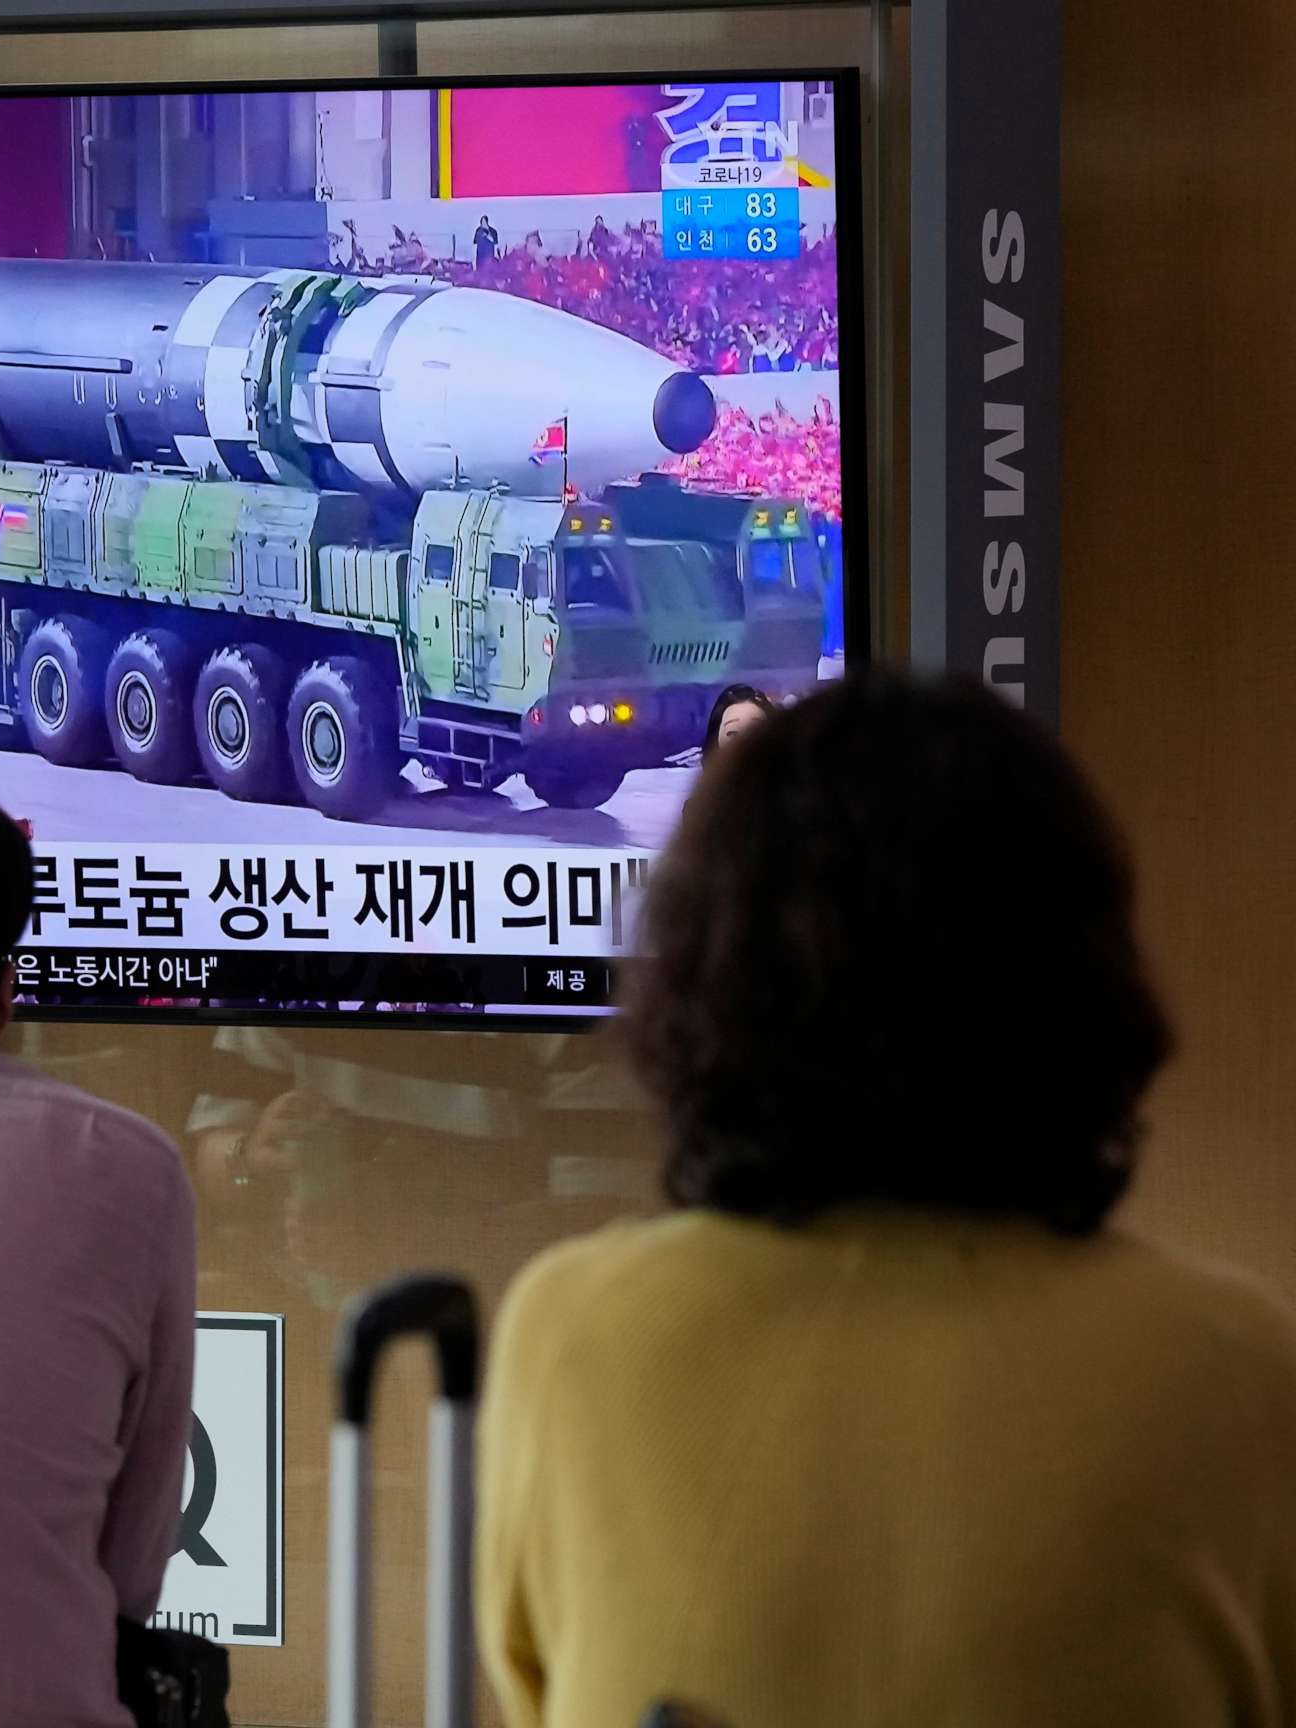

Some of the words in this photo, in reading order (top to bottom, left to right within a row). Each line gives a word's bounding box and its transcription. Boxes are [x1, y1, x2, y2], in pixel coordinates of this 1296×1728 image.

[698, 166, 762, 185] 코로나19
[746, 192, 777, 218] 83
[746, 227, 778, 252] 63
[208, 857, 334, 940] 생산
[353, 859, 476, 944] 재개
[501, 858, 649, 946] 의미"
[48, 955, 152, 987] 노동시간
[158, 956, 218, 988] 아냐"
[546, 969, 586, 991] 제공
